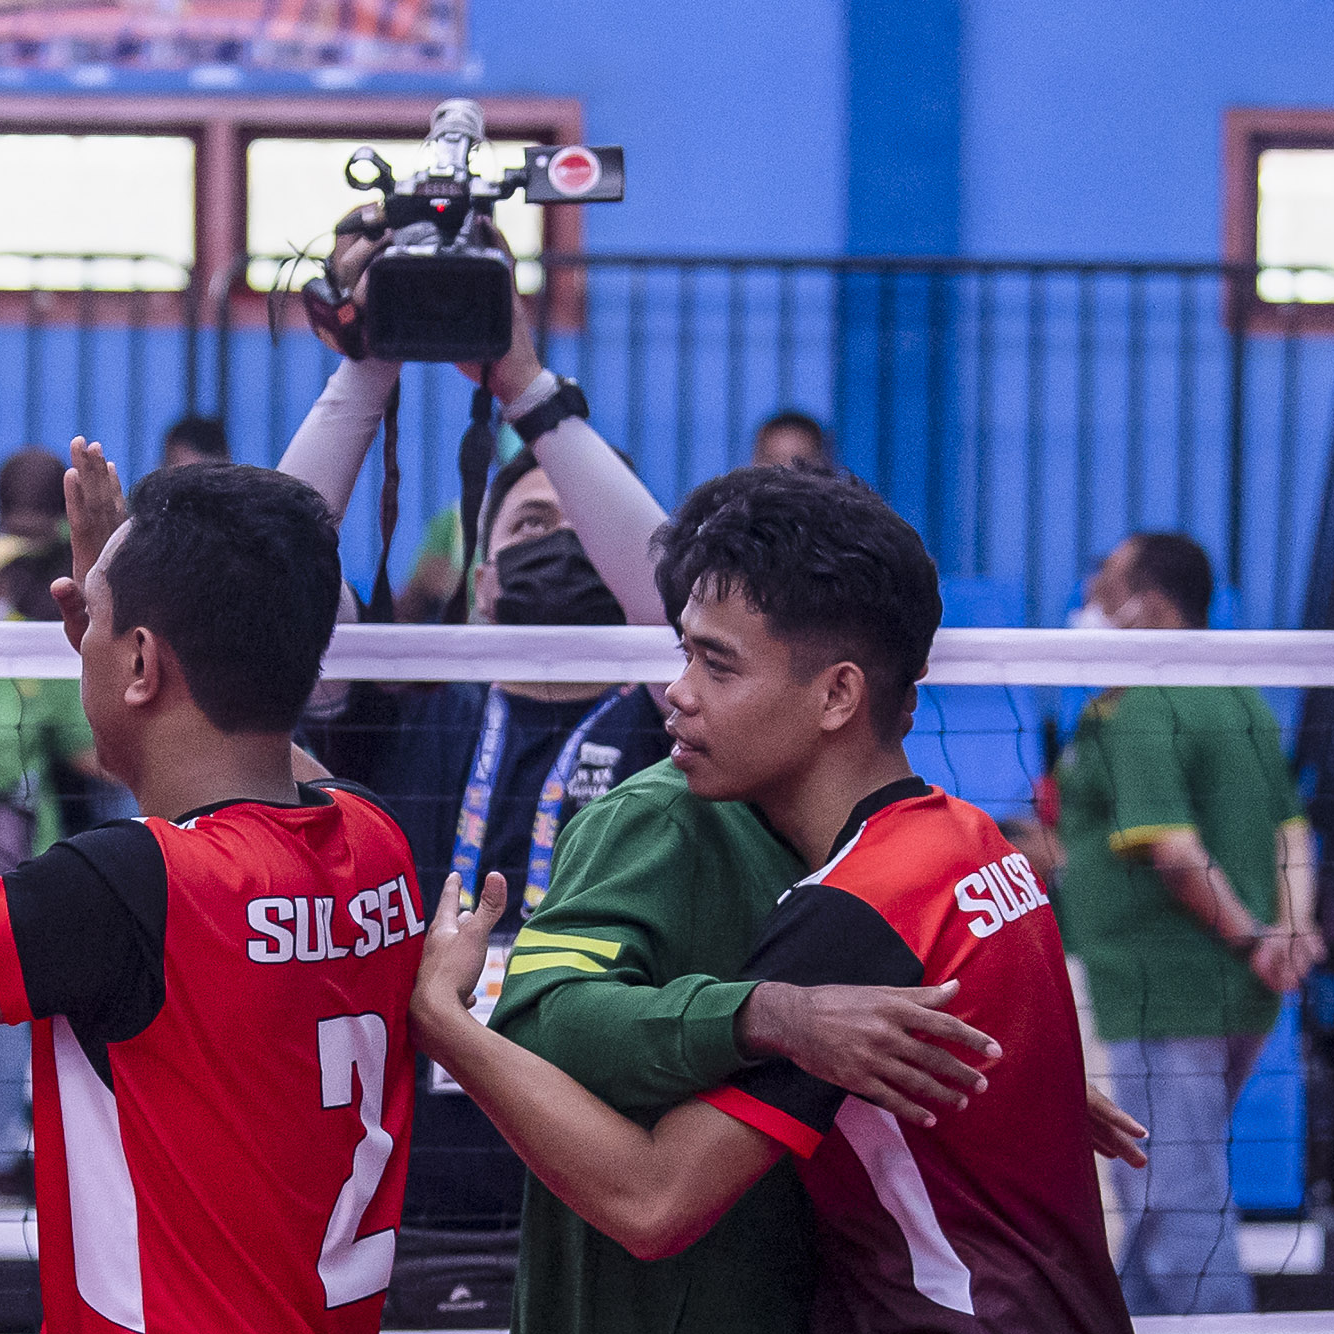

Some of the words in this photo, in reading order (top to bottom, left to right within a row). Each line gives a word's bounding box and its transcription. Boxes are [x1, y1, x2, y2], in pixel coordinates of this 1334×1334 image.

[246, 872, 425, 965] SULSEL
[953, 852, 1050, 939] SULSE
[316, 1009, 395, 1311] 2
